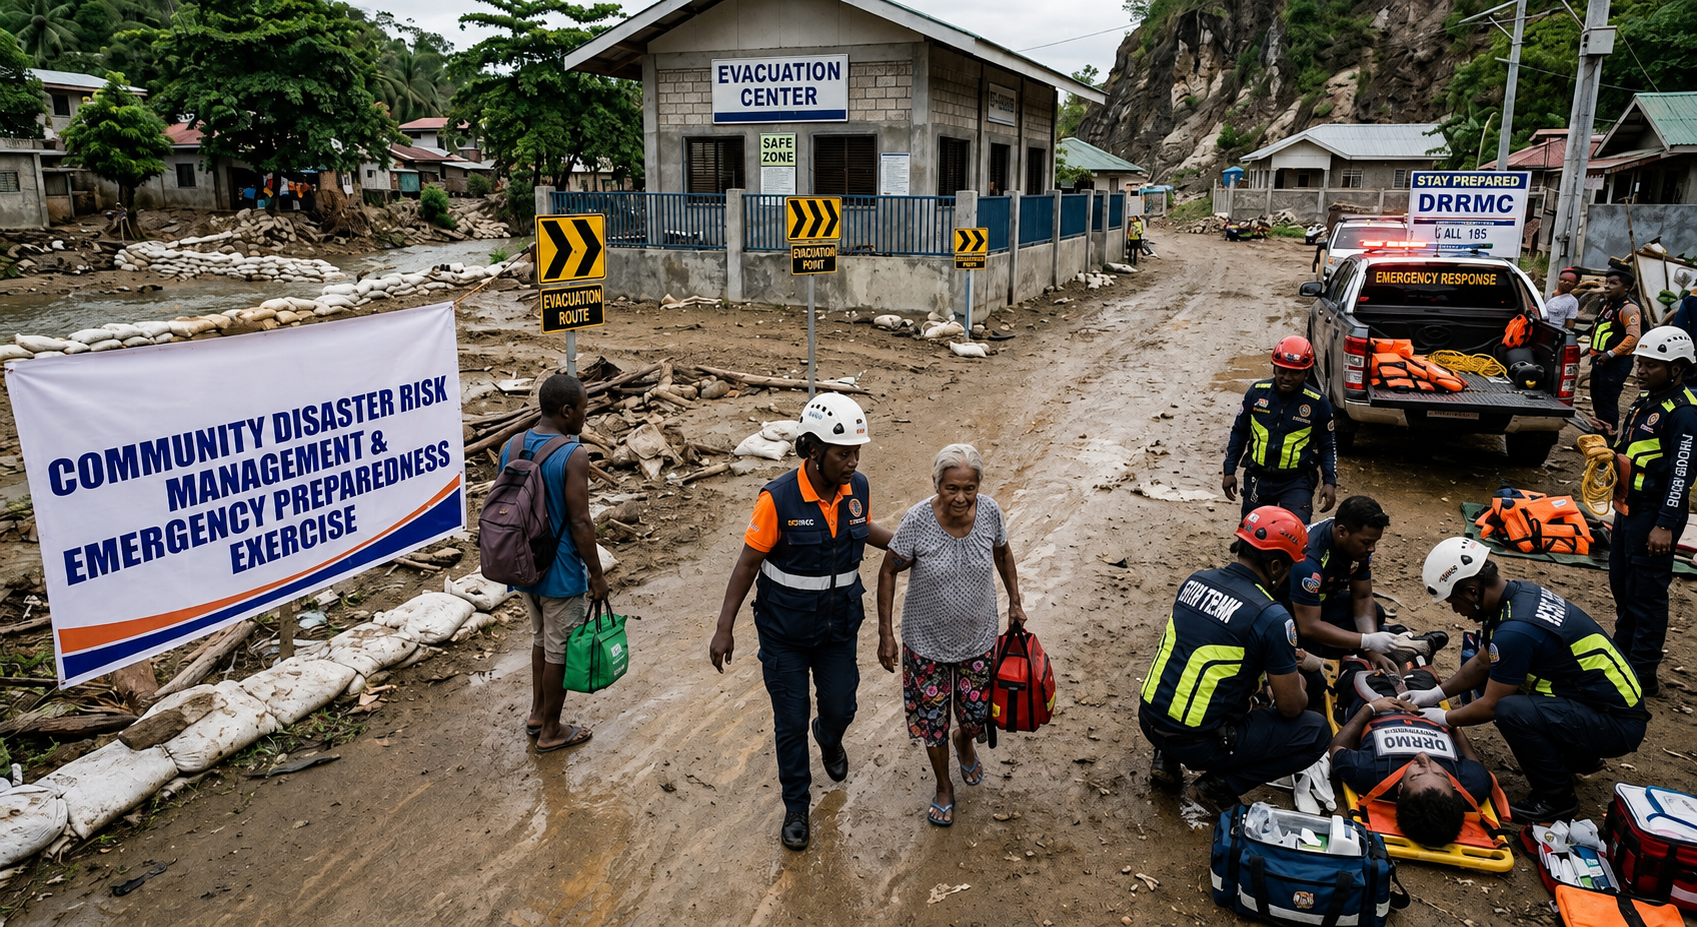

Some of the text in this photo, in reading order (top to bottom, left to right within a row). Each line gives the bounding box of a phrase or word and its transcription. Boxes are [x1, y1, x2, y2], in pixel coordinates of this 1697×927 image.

[718, 61, 840, 84] EVACUATION
[740, 86, 818, 107] CENTER
[763, 137, 793, 149] SAFE
[762, 151, 794, 163] ZONE
[1417, 175, 1520, 187] STAY PREPARED
[1418, 193, 1514, 214] DRRMC
[1468, 228, 1488, 240] 185
[1375, 271, 1498, 286] EMERGENCY RESPONSE
[543, 288, 602, 310] EVACUATION
[559, 307, 590, 326] ROUTE
[48, 375, 448, 497] COMMUNITY DISASTER RISK
[166, 429, 388, 513] MANAGEMENT &
[63, 440, 451, 587] EMERGENCY PREPAREDNESS
[230, 504, 358, 575] EXERCISE
[1384, 735, 1448, 752] DRRMO
